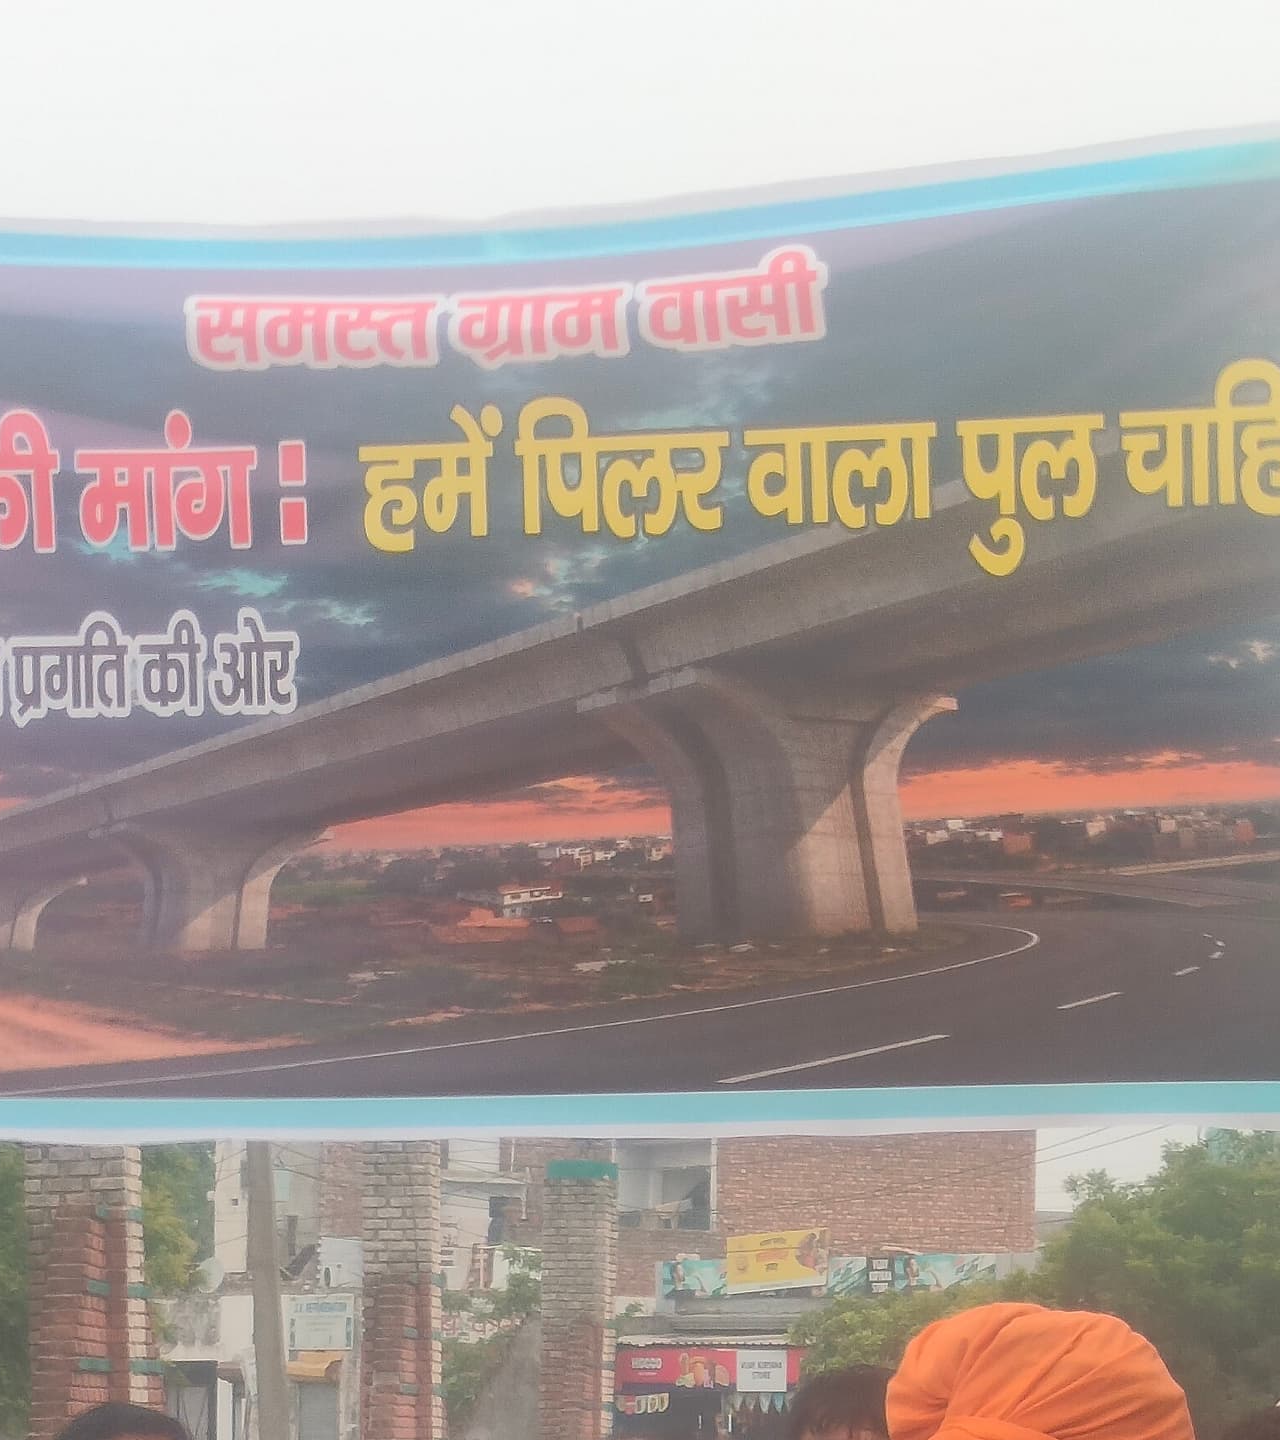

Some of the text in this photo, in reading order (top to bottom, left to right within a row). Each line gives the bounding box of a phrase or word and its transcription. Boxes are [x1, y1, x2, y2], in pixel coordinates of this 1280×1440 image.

[194, 250, 821, 361] समस्त ग्राम वासी
[76, 411, 257, 549] मांग
[358, 405, 502, 553] हमें
[515, 397, 729, 540] पिलर
[743, 420, 937, 530] वाला
[955, 412, 1106, 578] पुल
[13, 617, 128, 721] प्रगति
[137, 613, 203, 711] की
[214, 611, 296, 712] ओर
